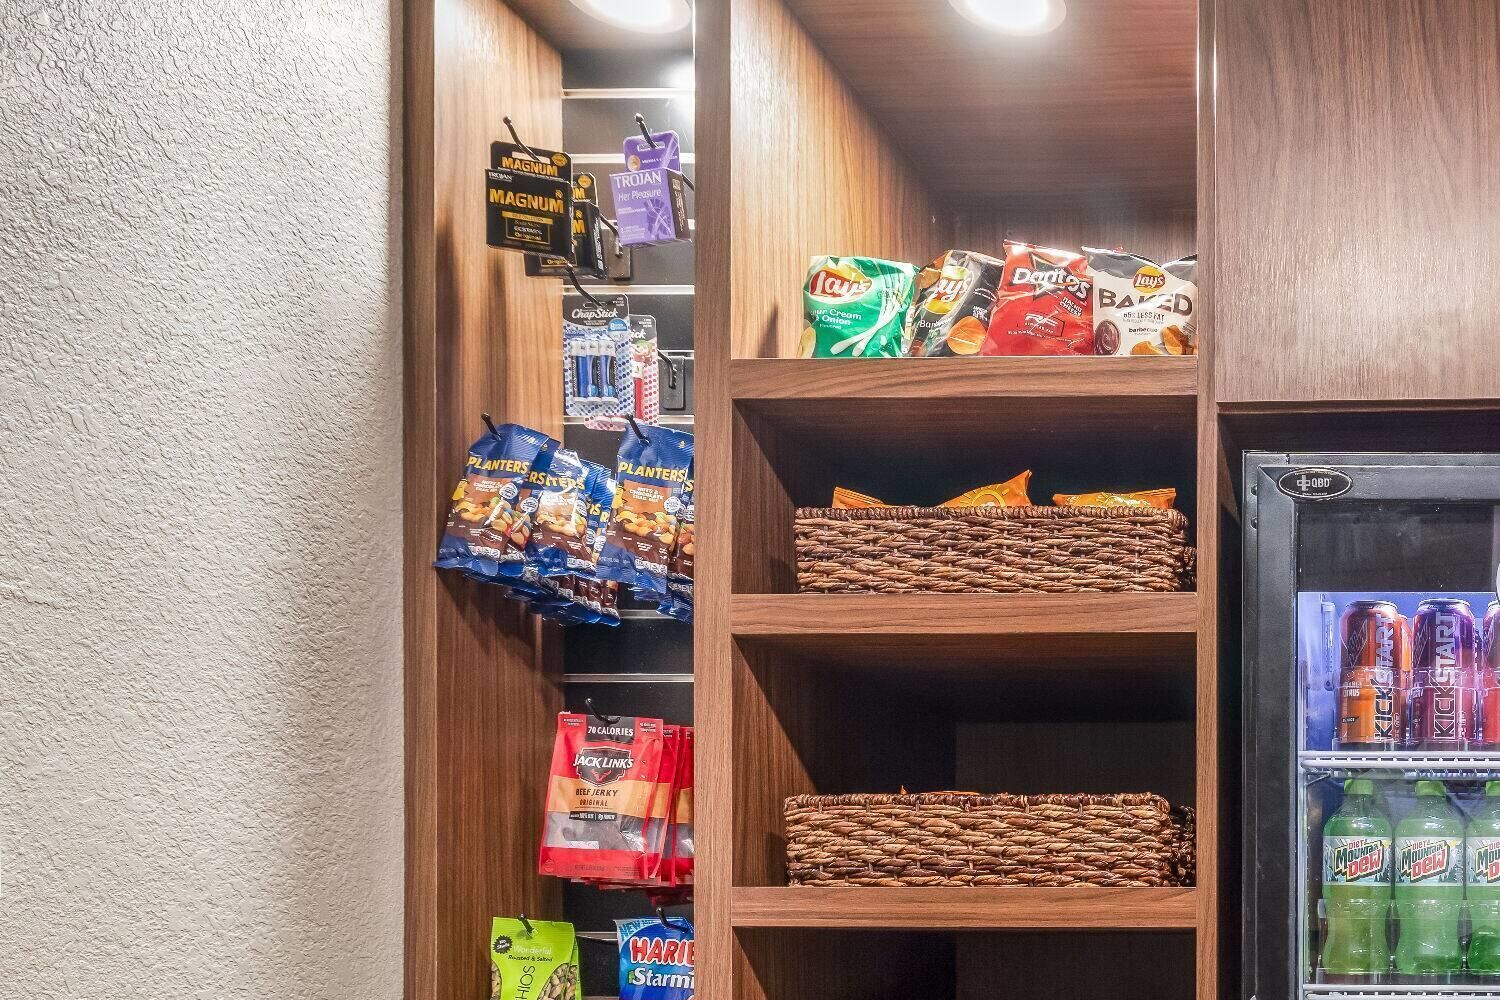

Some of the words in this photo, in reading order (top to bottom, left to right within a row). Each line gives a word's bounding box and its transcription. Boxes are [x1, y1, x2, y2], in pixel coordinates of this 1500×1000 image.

[501, 156, 559, 176] MAGNUM
[613, 171, 662, 189] TROJAN
[489, 188, 564, 214] MAGNUM
[618, 193, 631, 202] Her
[631, 188, 662, 200] Pleasure
[1012, 267, 1091, 299] Doritos
[1135, 273, 1164, 288] Lay's
[571, 308, 619, 320] ChapStick
[821, 315, 852, 325] Onion
[830, 308, 862, 321] Cream
[466, 456, 530, 475] PLANTERS
[618, 461, 686, 483] PLANTERS
[1311, 477, 1330, 488] QBD
[1371, 613, 1394, 739] KICKSTART
[1429, 613, 1456, 738] KICKSTART
[587, 726, 596, 734] 70
[597, 726, 634, 737] CALORIES
[573, 754, 601, 768] JACK
[575, 788, 591, 796] BEEF
[591, 789, 619, 797] JERKY
[579, 798, 608, 807] ORIGINAL
